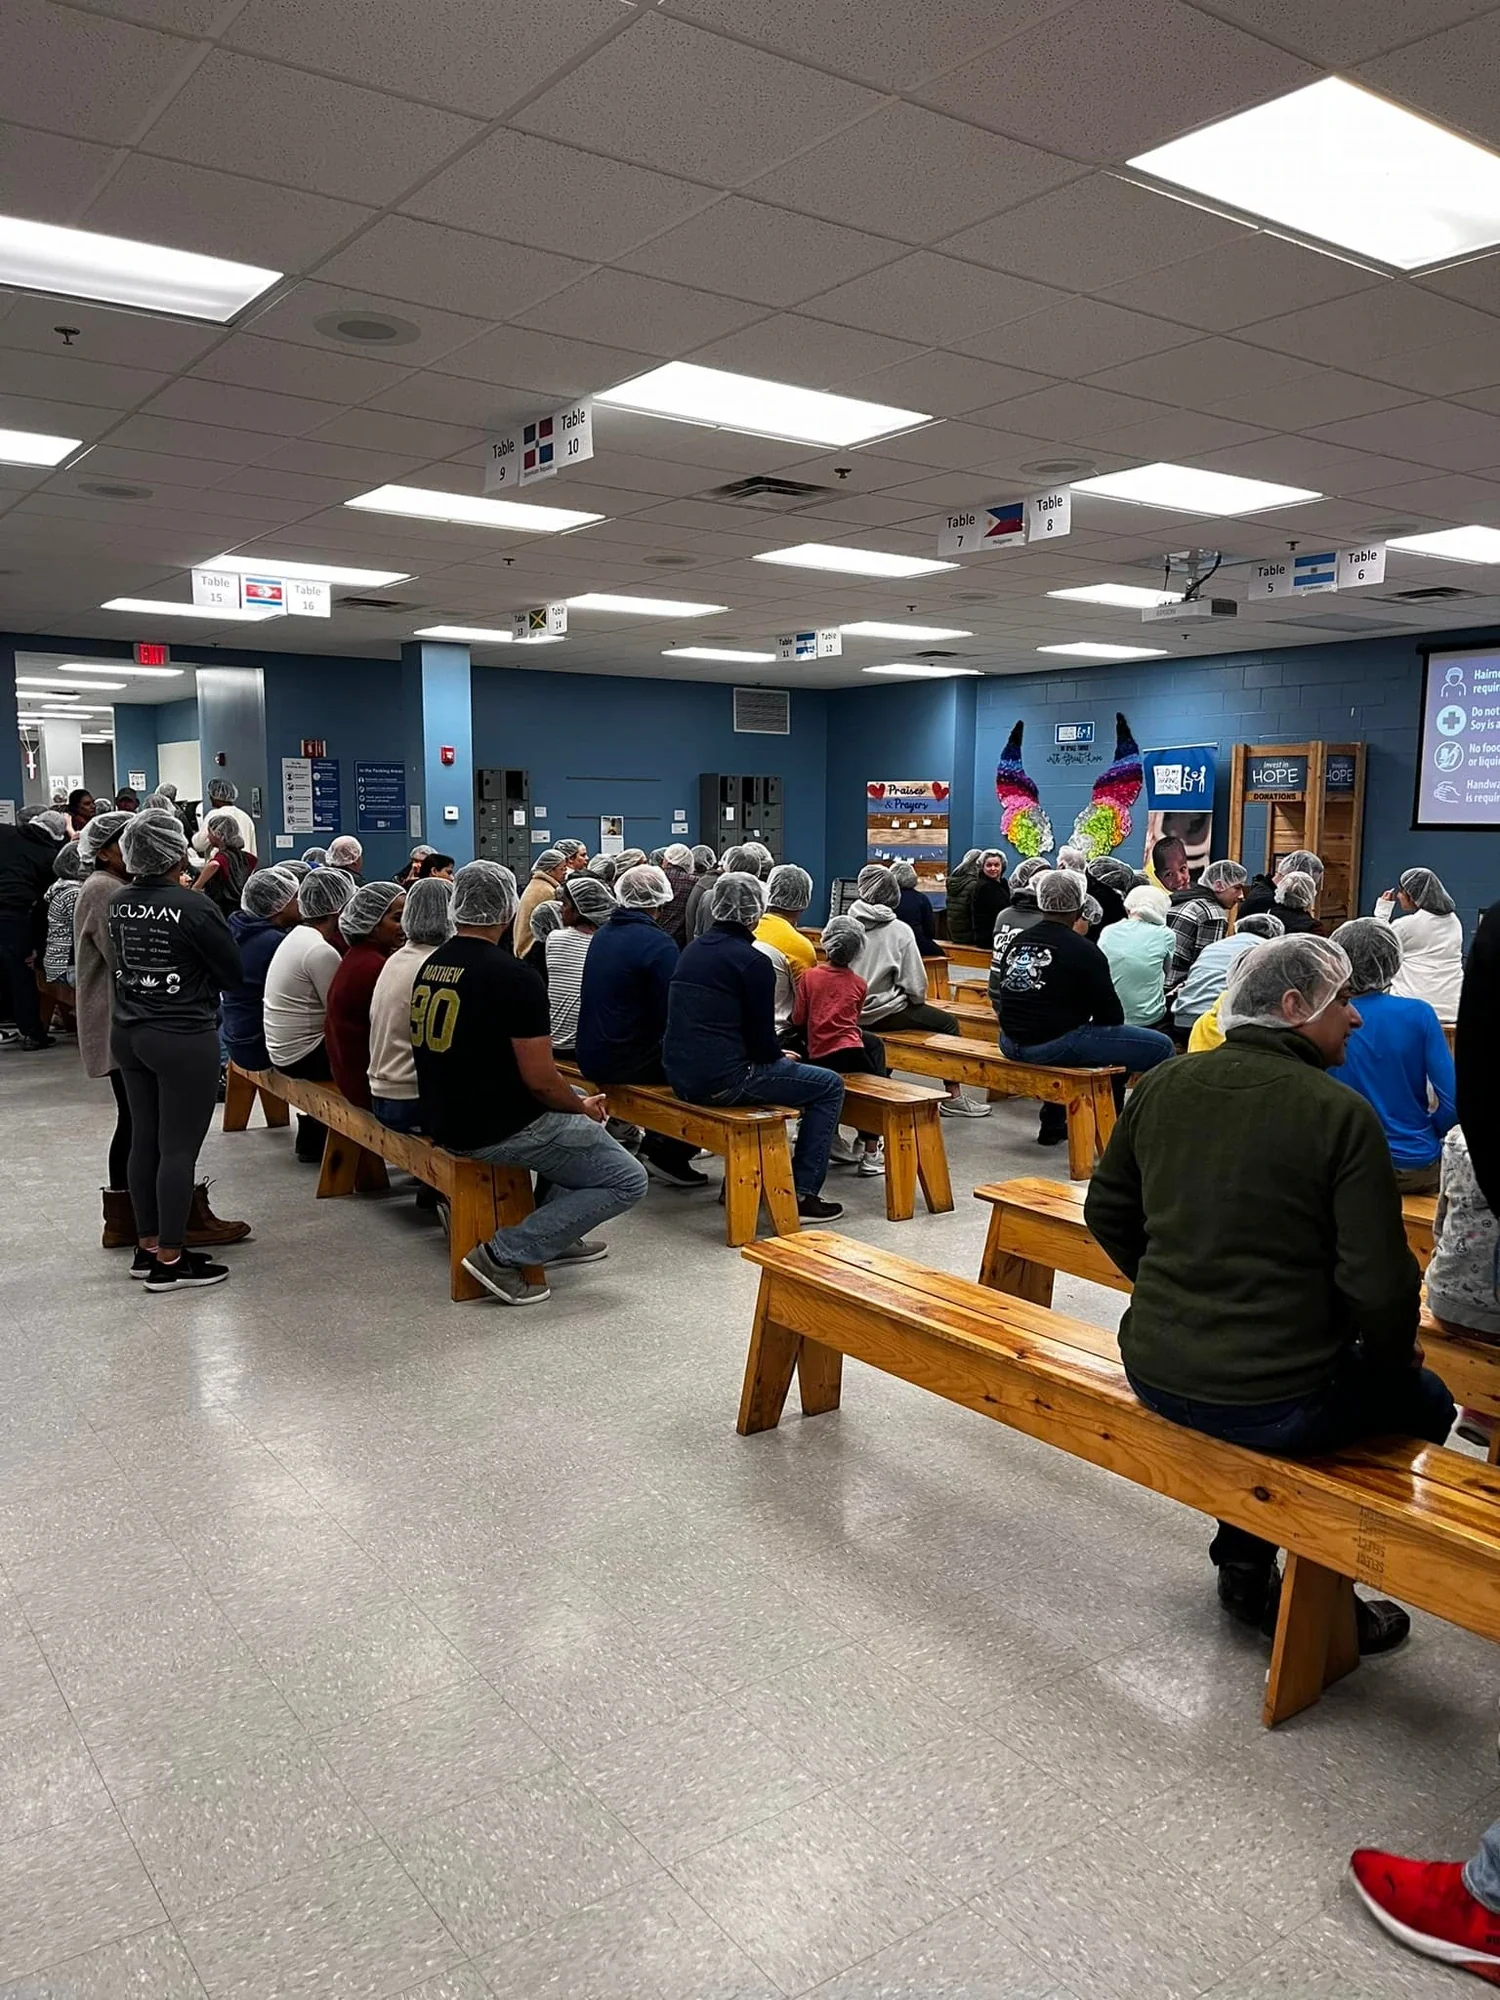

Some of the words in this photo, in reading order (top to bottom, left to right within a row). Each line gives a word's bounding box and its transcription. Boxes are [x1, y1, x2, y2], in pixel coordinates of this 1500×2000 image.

[561, 408, 586, 430] Table
[492, 438, 515, 459] Table
[567, 438, 579, 455] 10
[499, 467, 506, 481] 9
[1036, 495, 1063, 512] Table
[947, 513, 976, 529] Table
[1046, 518, 1053, 531] 8
[957, 535, 964, 548] 7
[1348, 549, 1377, 564] Table
[1257, 564, 1286, 577] Table
[1357, 569, 1365, 580] 6
[201, 576, 230, 588] Table
[1267, 582, 1274, 593] 5
[295, 585, 321, 596] Table
[210, 593, 223, 602] 15
[302, 601, 315, 610] 16
[1472, 706, 1483, 717] Do
[1470, 719, 1486, 732] Soy
[1487, 719, 1494, 729] is
[1469, 743, 1481, 753] No
[1468, 758, 1477, 766] or
[1252, 768, 1299, 784] HOPE
[52, 779, 64, 788] 10
[72, 779, 79, 788] 9
[888, 784, 926, 795] Praises
[1465, 792, 1473, 802] is
[885, 800, 894, 809] &
[894, 797, 929, 813] Prayers
[422, 964, 465, 983] MATHEW
